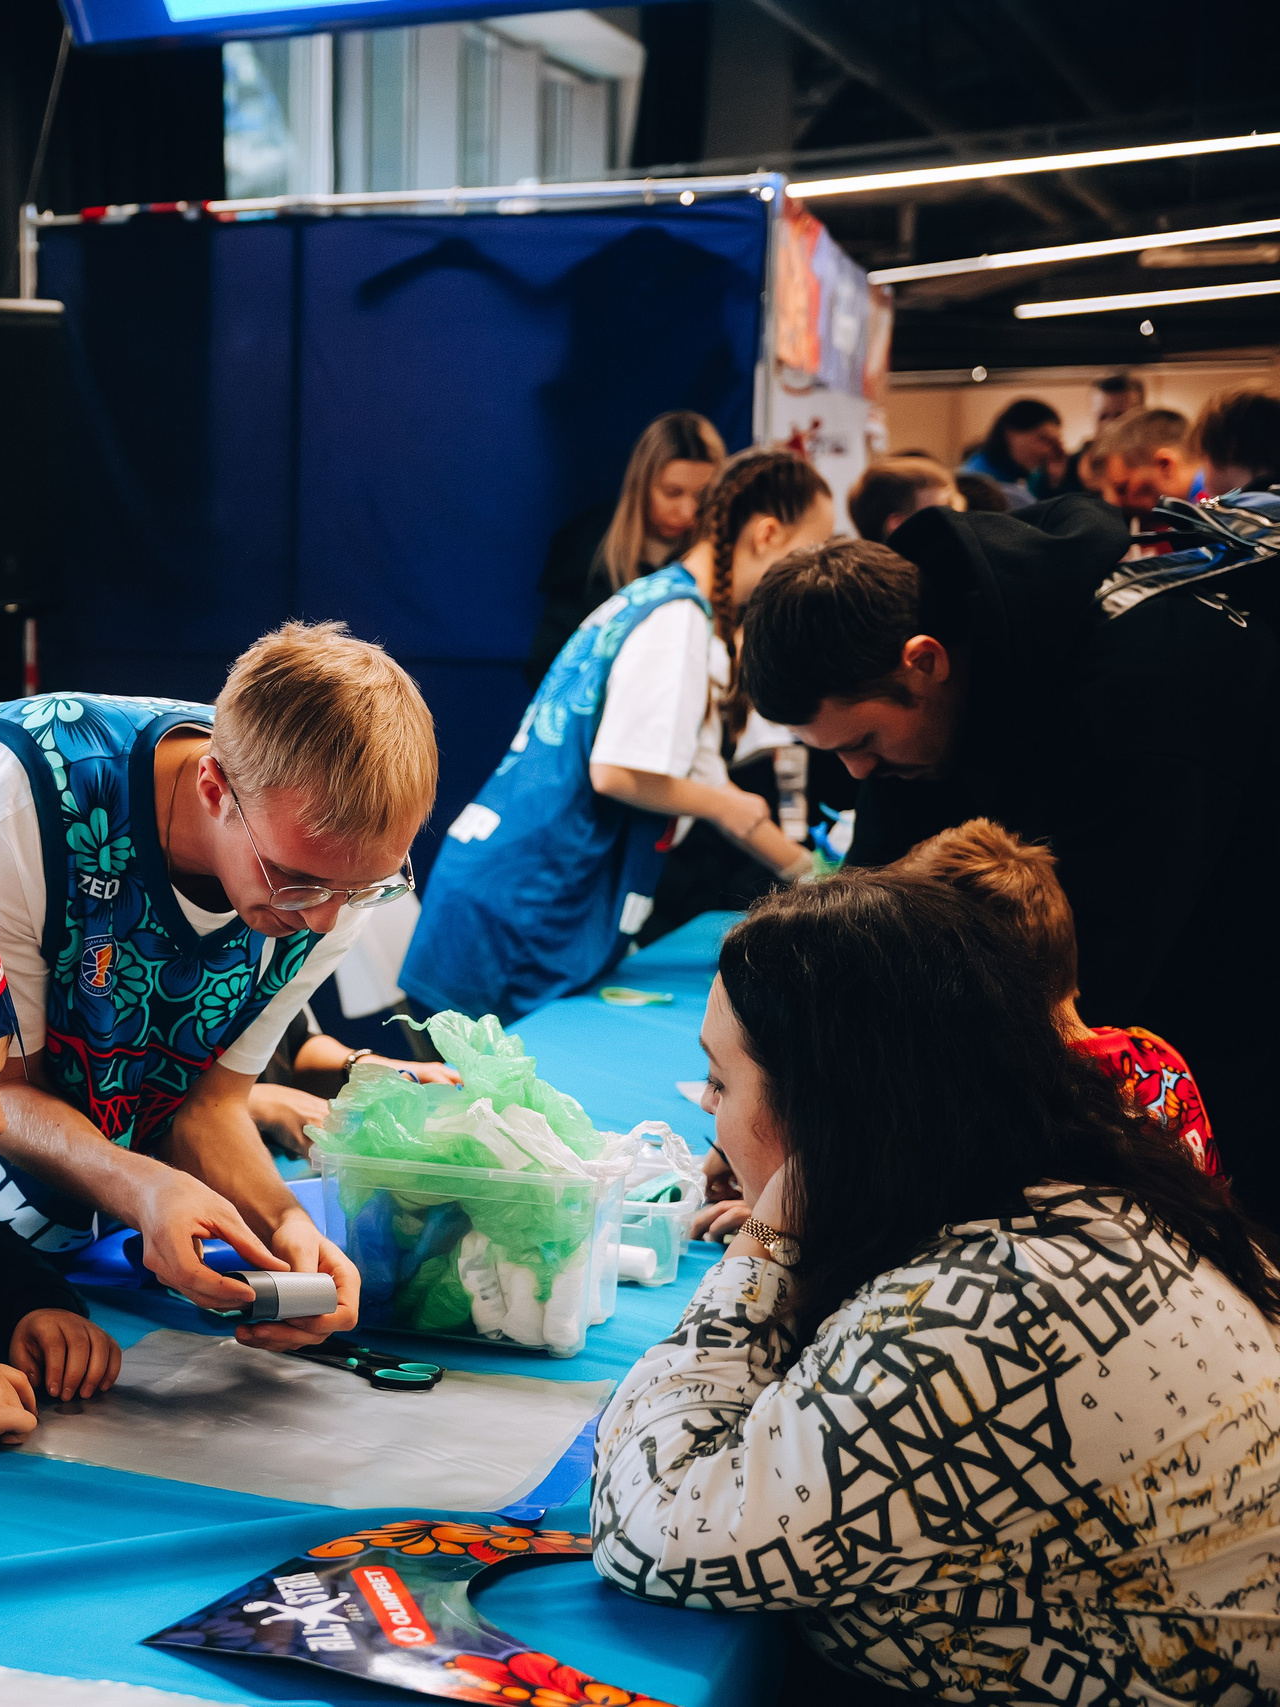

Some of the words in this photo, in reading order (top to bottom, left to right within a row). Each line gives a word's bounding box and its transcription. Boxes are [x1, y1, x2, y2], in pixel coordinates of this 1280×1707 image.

[273, 1572, 329, 1605] STAR
[363, 1570, 412, 1626] OLIMPBET
[302, 1623, 358, 1651] ALL
